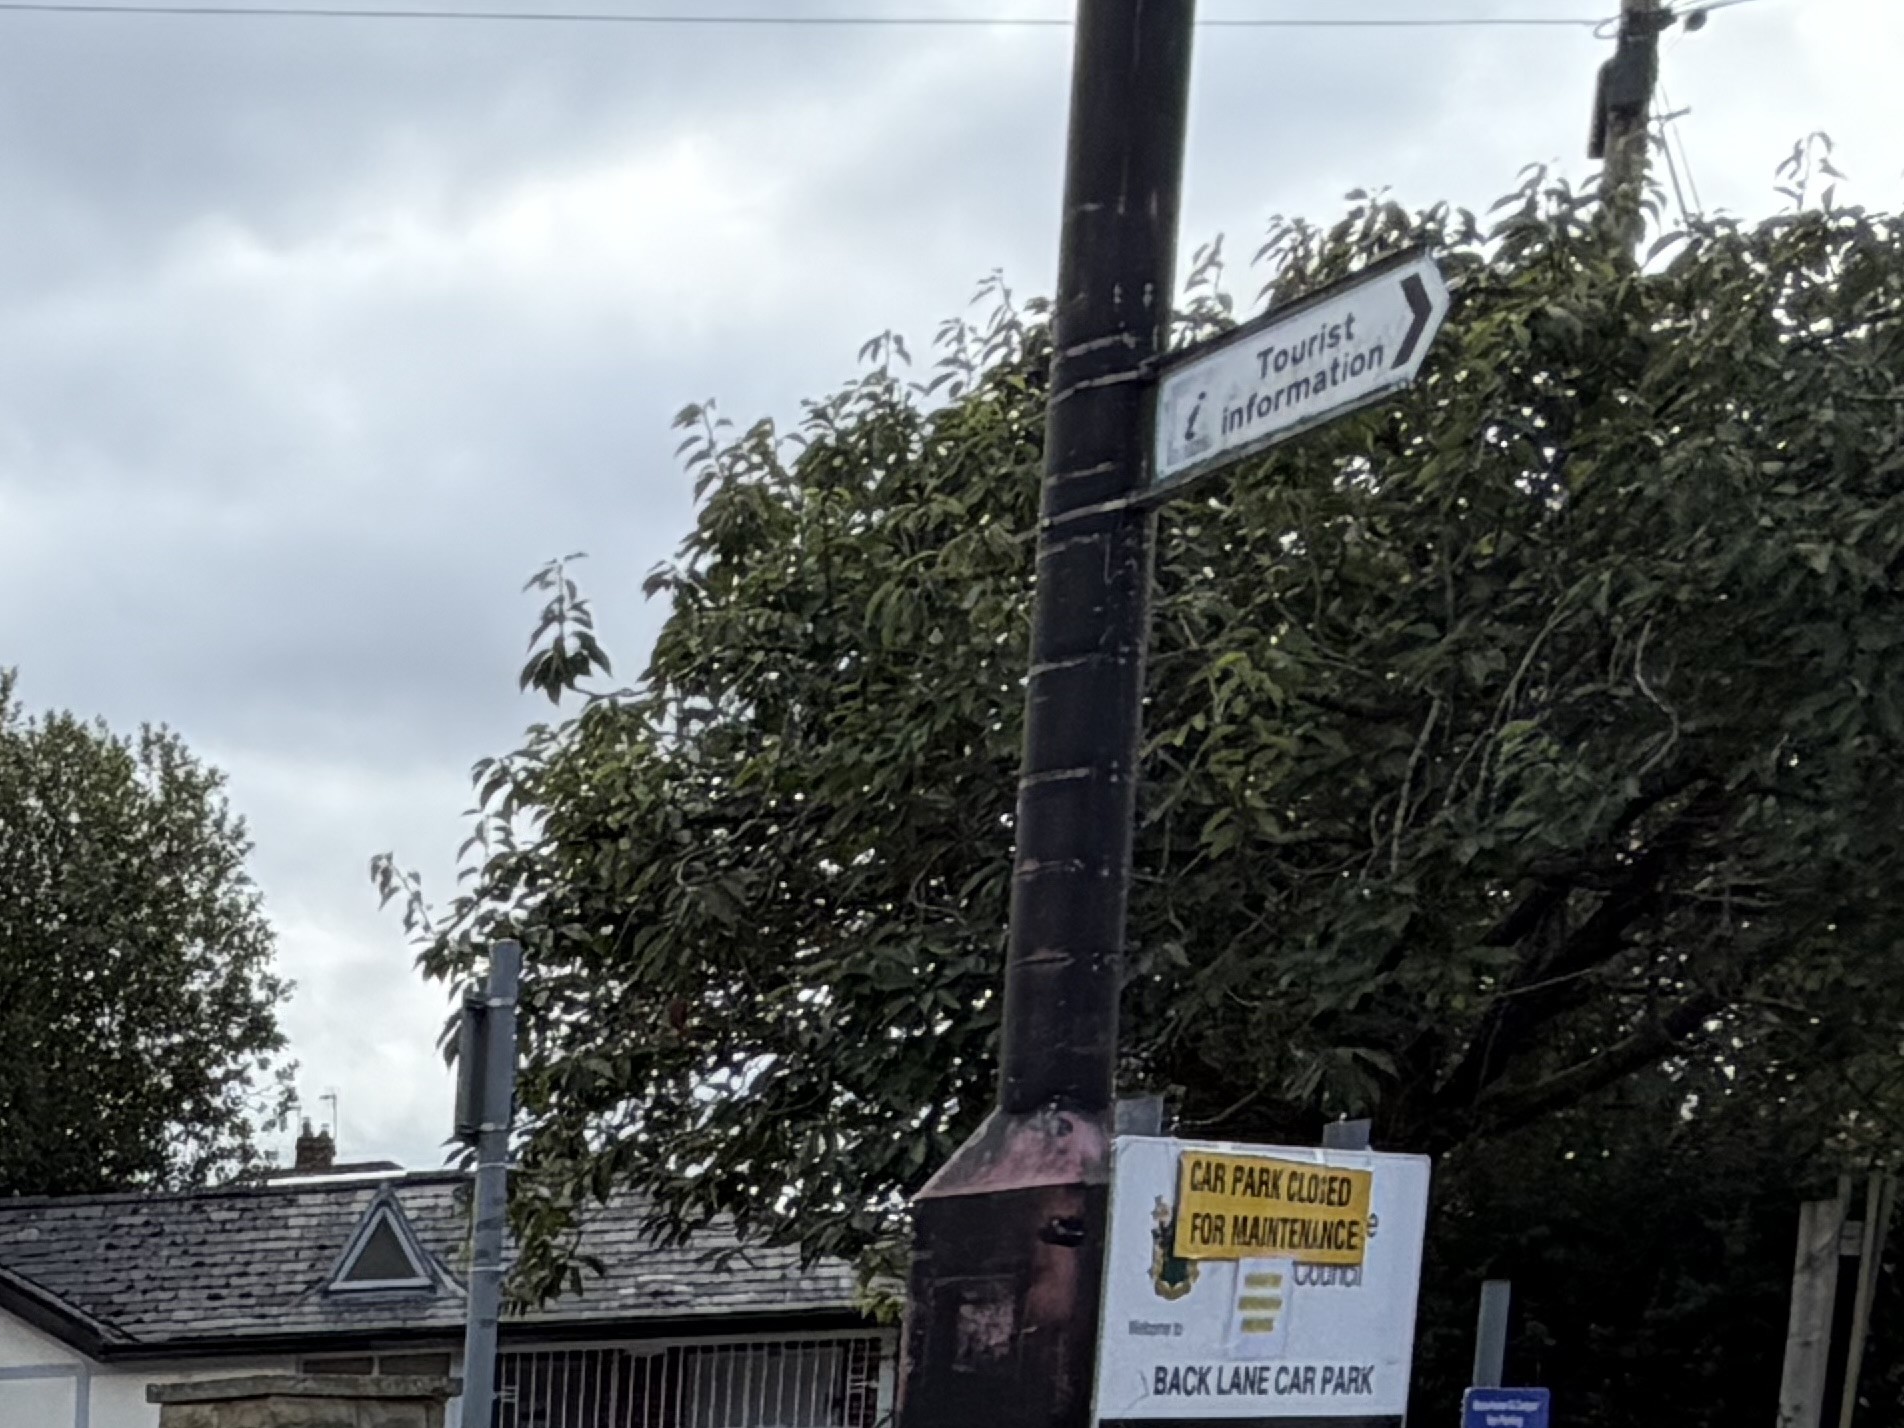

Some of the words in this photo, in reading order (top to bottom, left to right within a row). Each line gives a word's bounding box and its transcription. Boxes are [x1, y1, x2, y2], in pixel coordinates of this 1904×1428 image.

[1257, 312, 1355, 379] Tourist
[1221, 344, 1384, 435] information
[1191, 1160, 1225, 1194] CAR
[1231, 1166, 1283, 1200] PARK
[1287, 1170, 1352, 1206] CLOSED
[1190, 1212, 1225, 1246] FOR
[1232, 1215, 1360, 1250] MAINTENANCE
[1153, 1366, 1212, 1396] BACK
[1216, 1366, 1271, 1395] LANE
[1275, 1365, 1316, 1395] CAR
[1321, 1365, 1375, 1395] PARK
